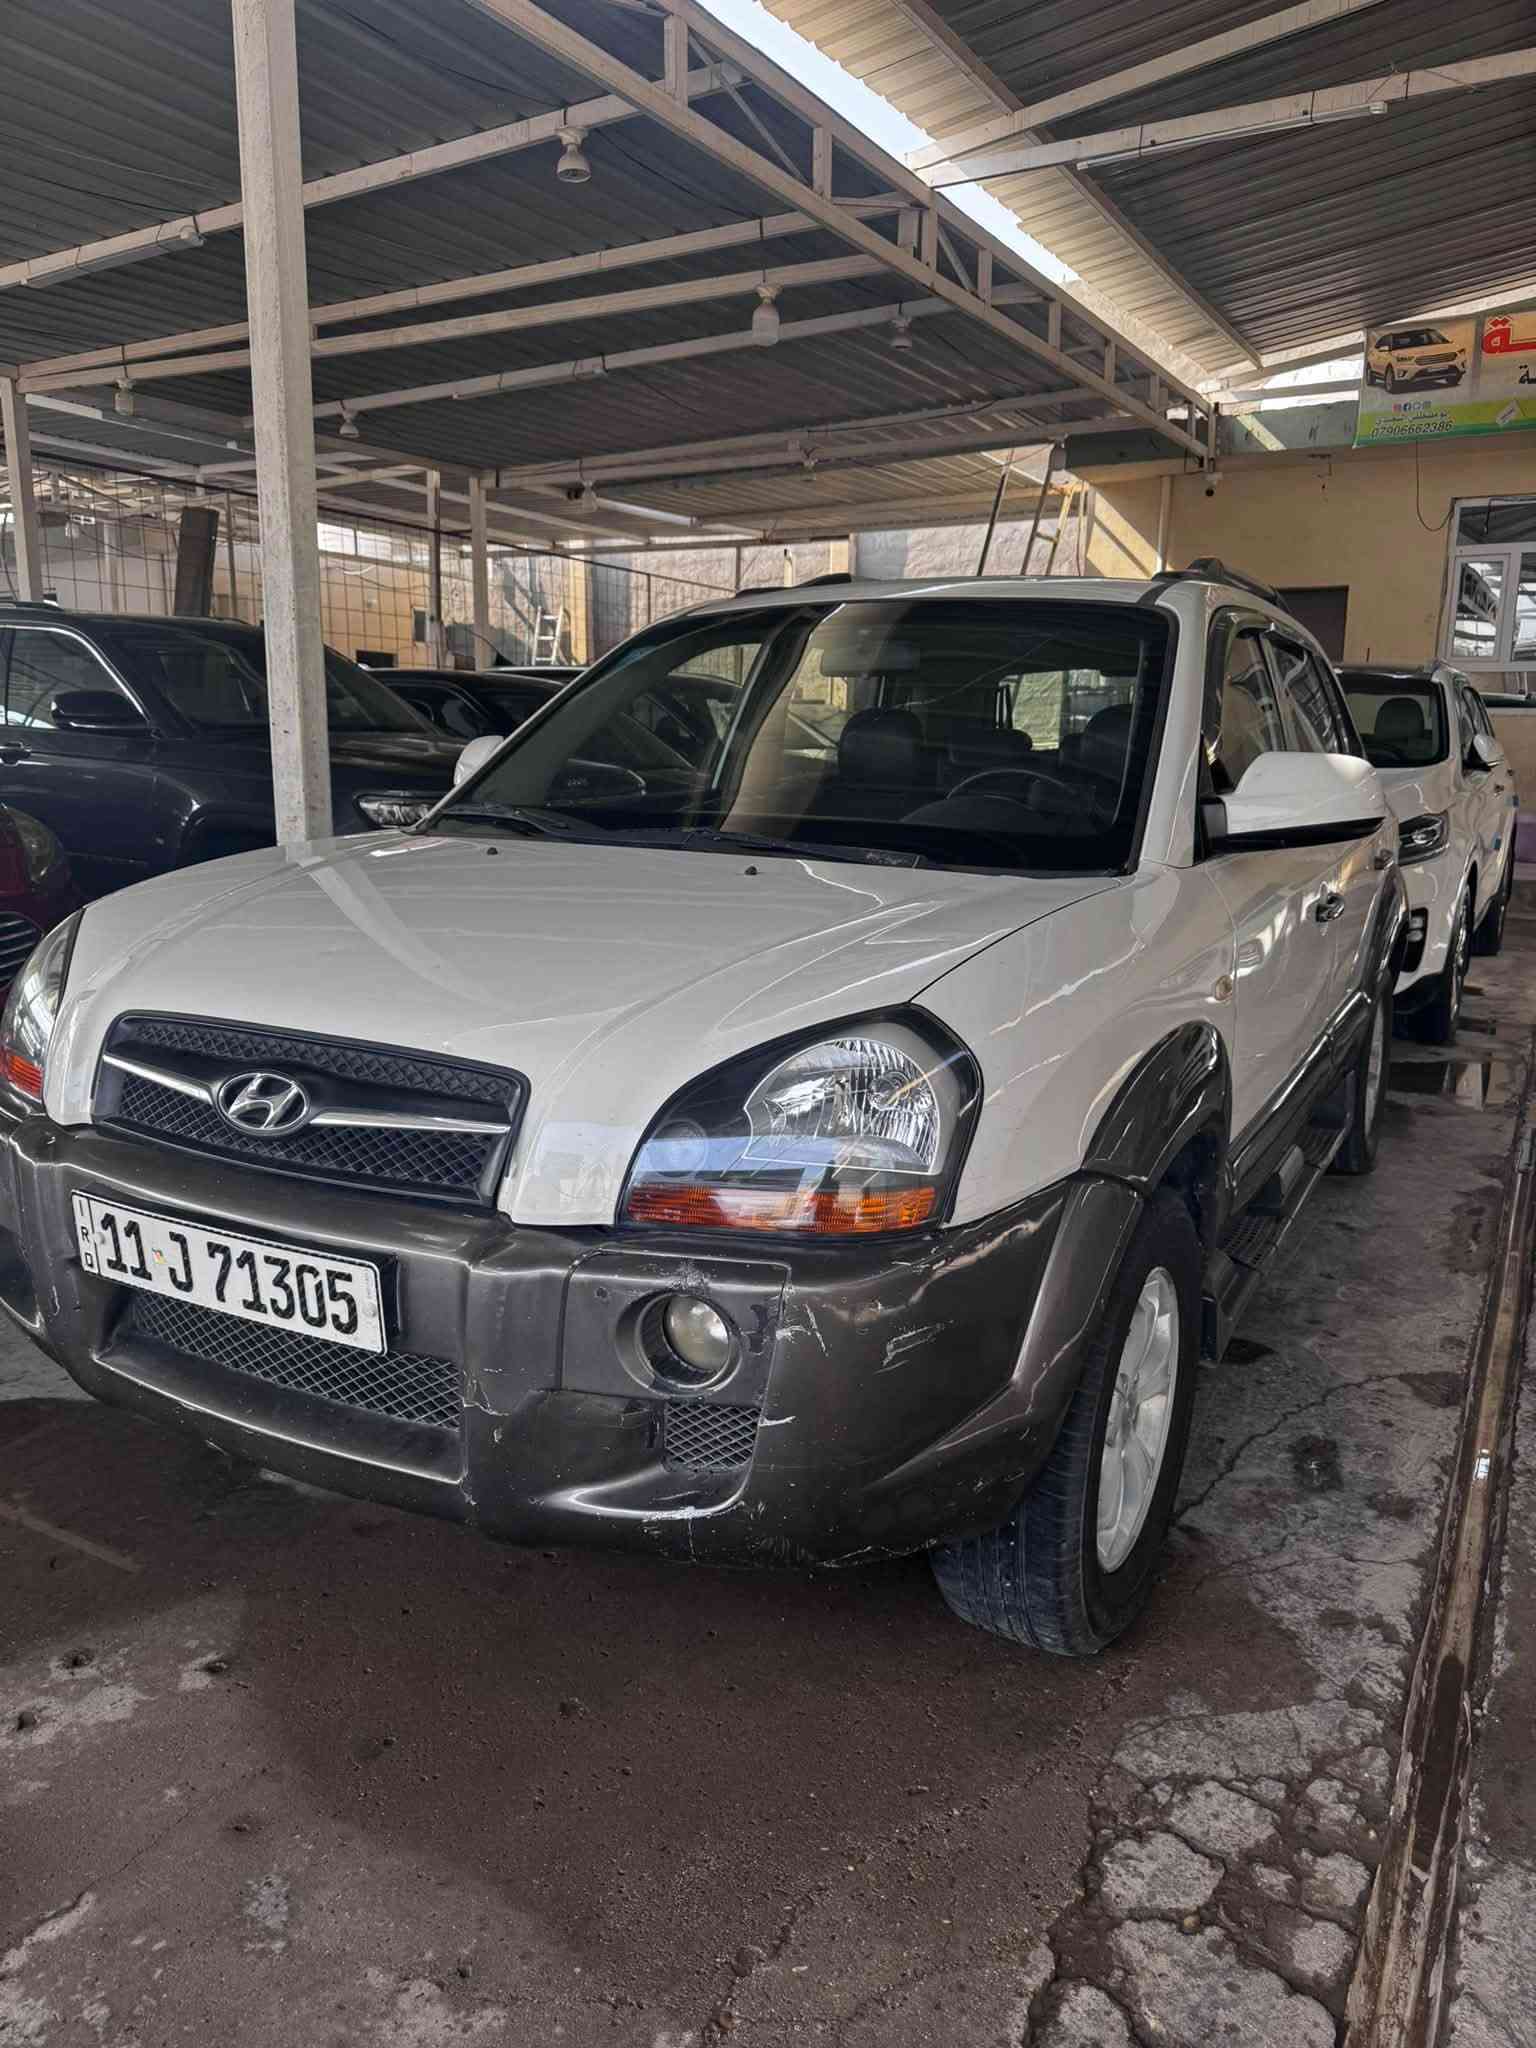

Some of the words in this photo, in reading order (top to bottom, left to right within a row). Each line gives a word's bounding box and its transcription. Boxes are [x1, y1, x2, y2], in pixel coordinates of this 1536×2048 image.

[101, 1213, 152, 1281] 11
[169, 1231, 193, 1292] J
[207, 1241, 357, 1335] 71305
